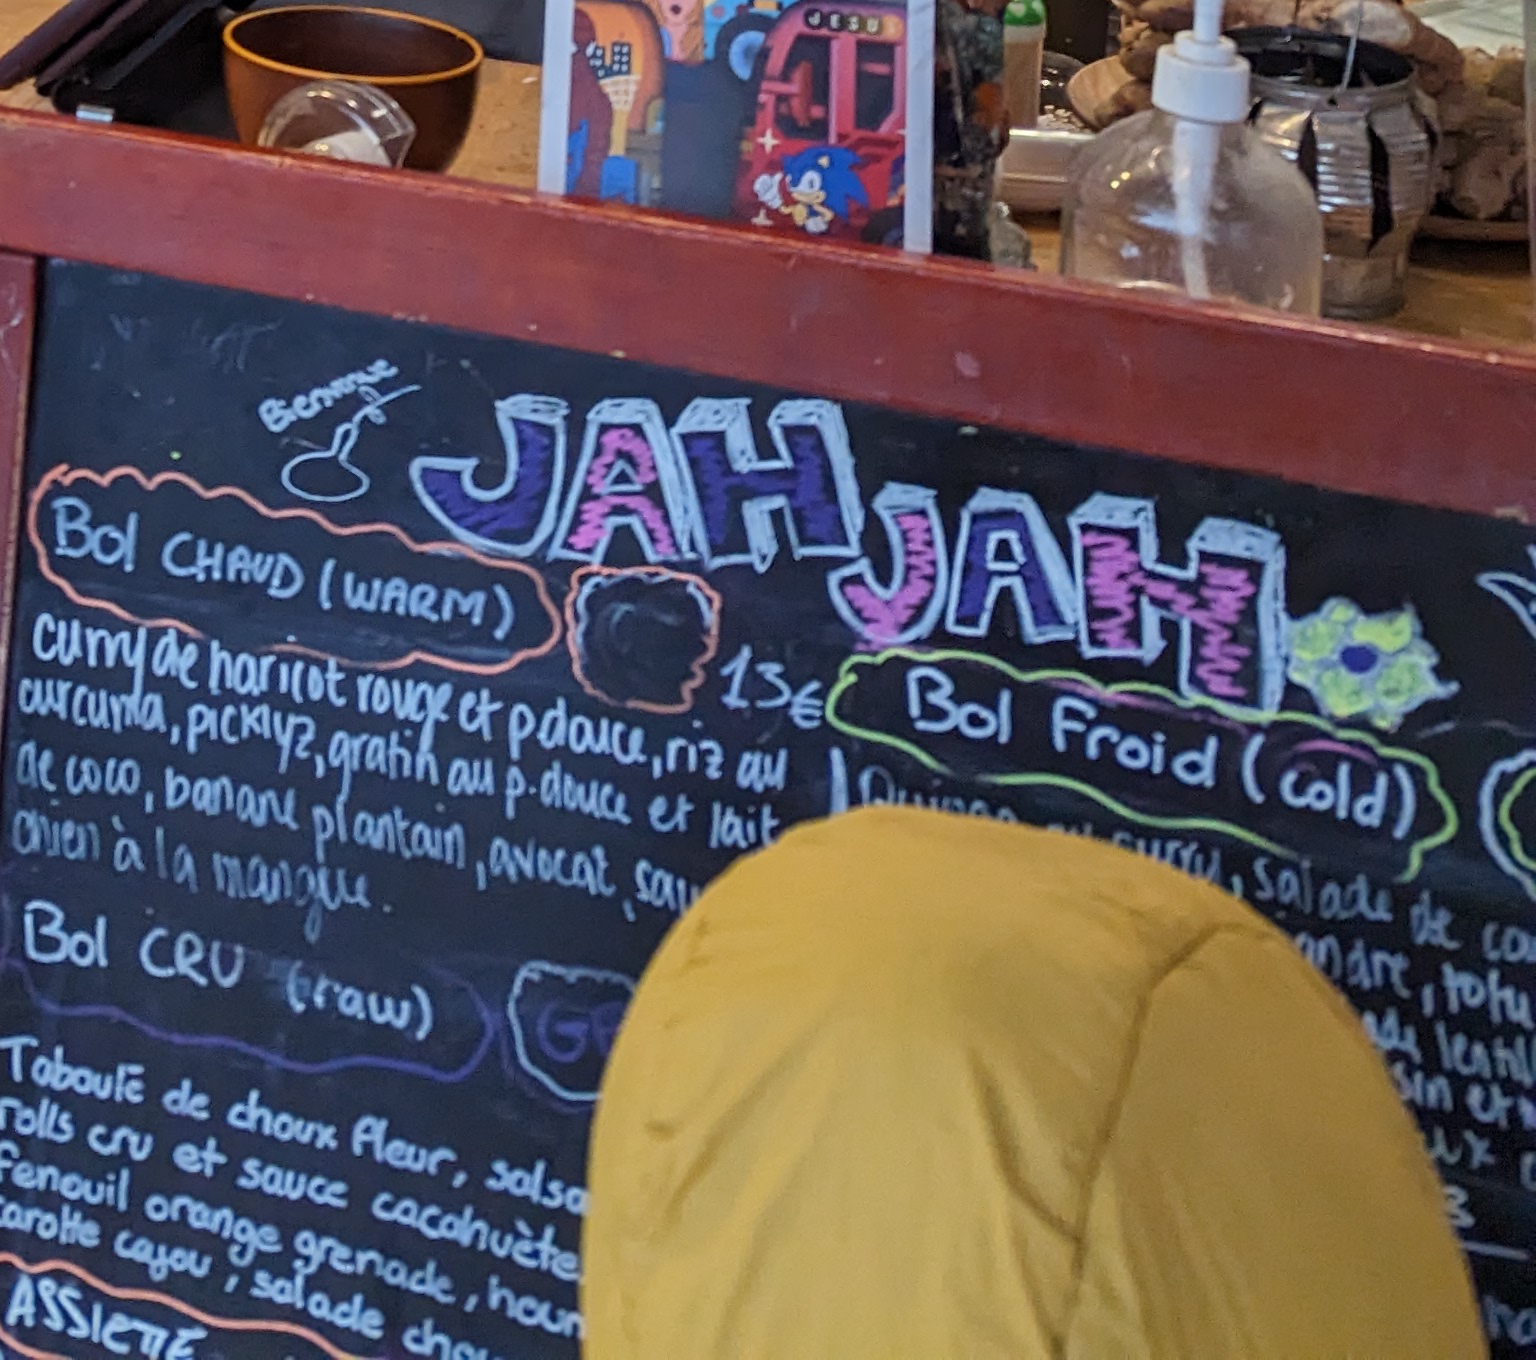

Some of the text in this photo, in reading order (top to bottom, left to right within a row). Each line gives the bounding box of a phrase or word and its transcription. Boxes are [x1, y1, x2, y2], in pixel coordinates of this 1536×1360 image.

[52, 496, 138, 573] Bol
[163, 534, 304, 599] CHAUD
[410, 392, 1287, 716] JAH JAH
[152, 629, 200, 689] de
[209, 639, 348, 708] haricot
[356, 674, 454, 752] rouge
[459, 688, 504, 740] et
[666, 718, 725, 779] riz
[736, 748, 788, 791] au
[908, 667, 1014, 743] Bol
[17, 740, 57, 792] de
[447, 757, 494, 796] au
[648, 793, 694, 833] et
[710, 801, 779, 848] lait
[155, 826, 198, 894] la
[23, 900, 433, 1041] Bol CRU (raw)
[162, 1078, 211, 1121] de
[226, 1088, 338, 1150] choux
[485, 1159, 589, 1216] salsa
[87, 1123, 154, 1162] cru
[172, 1135, 228, 1178] et
[237, 1157, 349, 1209] sauce
[371, 1191, 582, 1281] cacahuète
[144, 1194, 283, 1268] orange
[250, 1262, 386, 1340] salade
